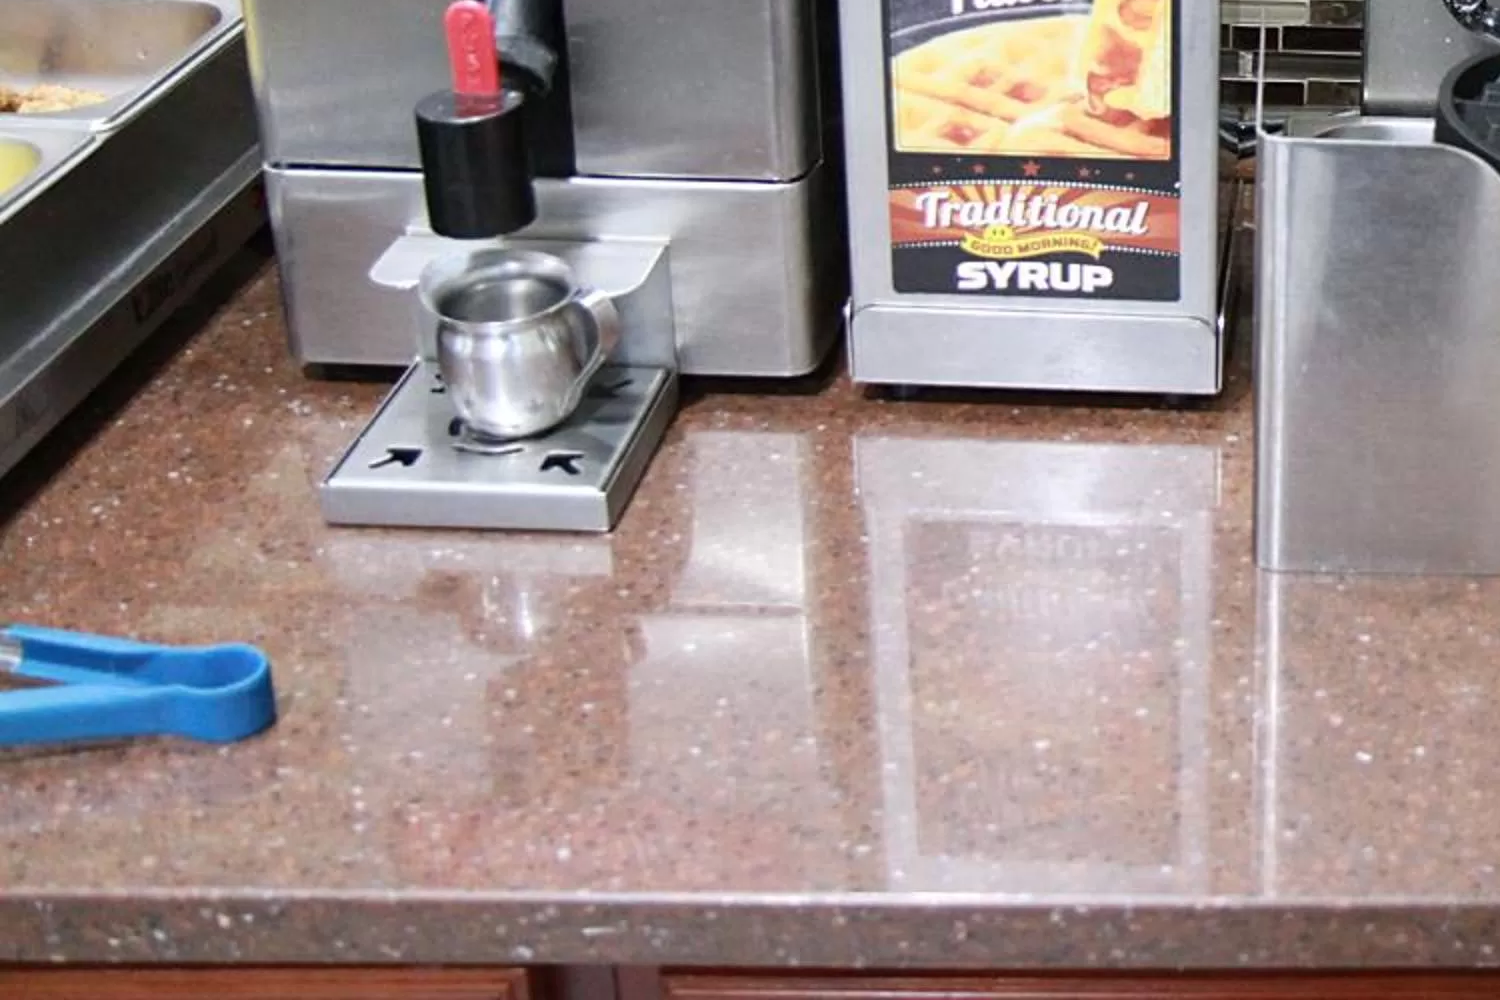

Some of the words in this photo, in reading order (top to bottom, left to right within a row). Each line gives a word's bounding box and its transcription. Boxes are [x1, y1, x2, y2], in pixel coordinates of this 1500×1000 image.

[916, 191, 1150, 234] Traditional
[970, 240, 1013, 255] GOOD
[957, 261, 1113, 293] SYRUP
